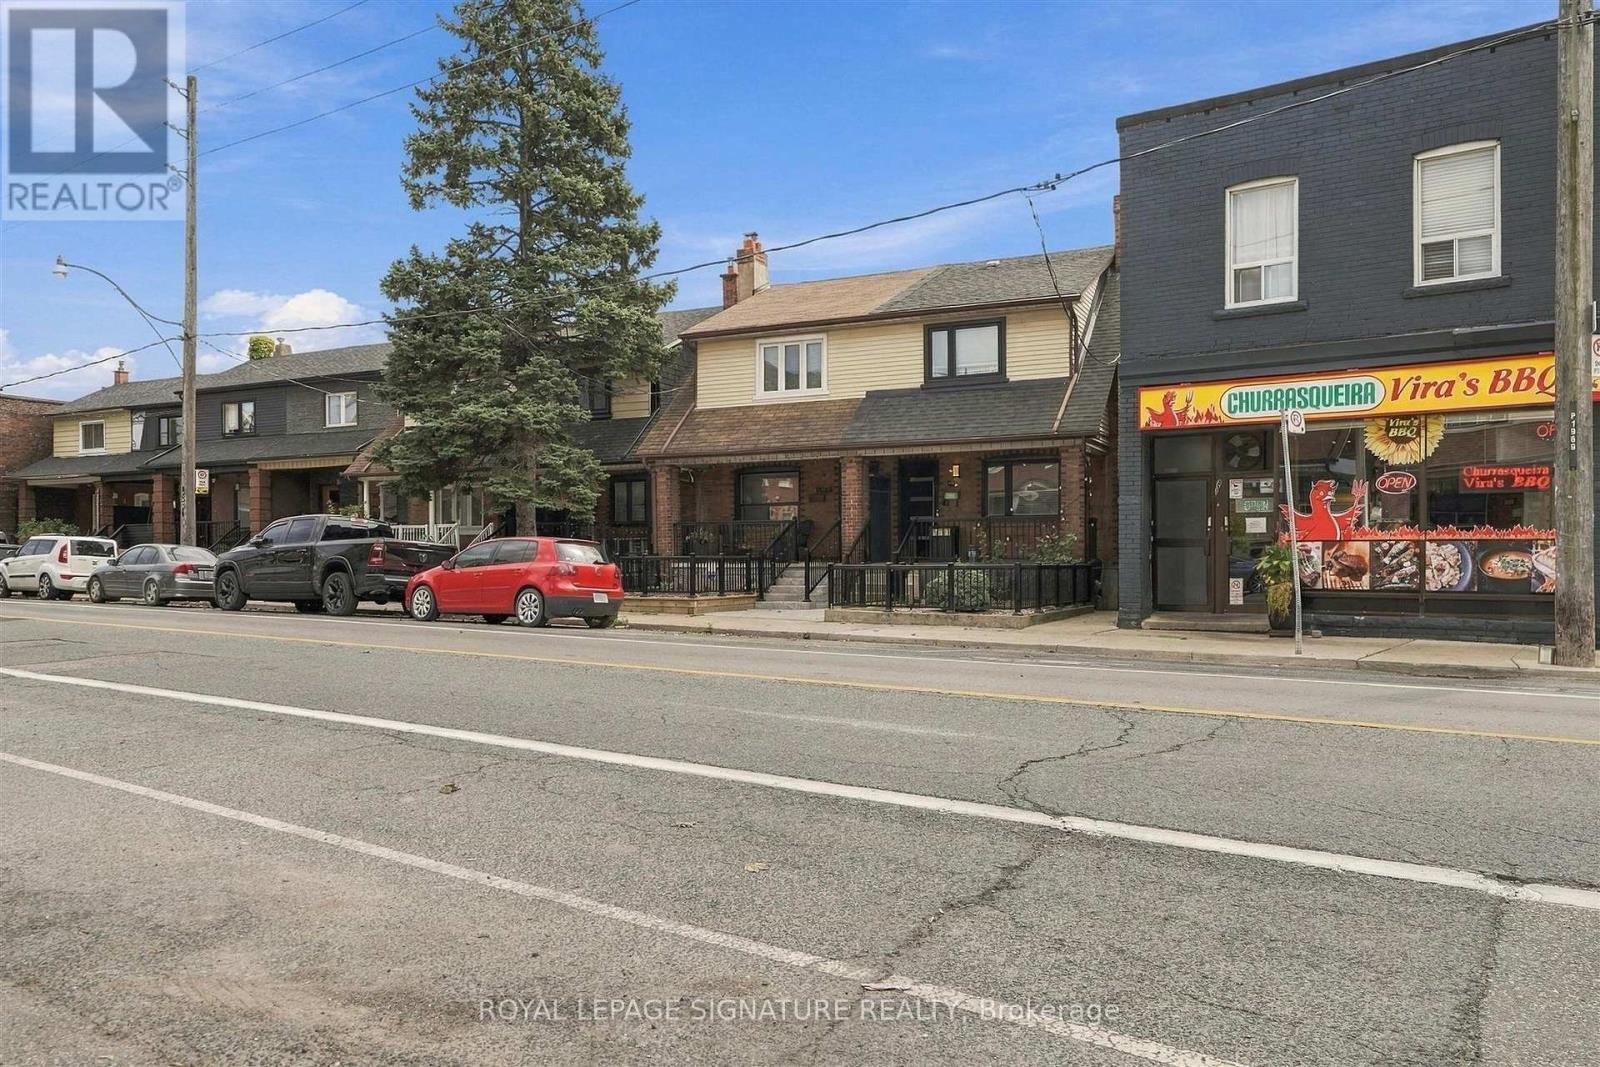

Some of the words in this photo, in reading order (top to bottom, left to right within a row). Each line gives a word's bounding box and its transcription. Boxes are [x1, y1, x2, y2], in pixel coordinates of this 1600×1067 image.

[1227, 381, 1376, 414] CHURRASQUEIRA
[1391, 372, 1480, 402] Vira's
[1488, 364, 1556, 398] BBQ
[1389, 427, 1417, 438] BBQ
[1379, 476, 1413, 489] OPEN
[1463, 477, 1505, 488] Vira's
[1512, 476, 1550, 489] BBQ
